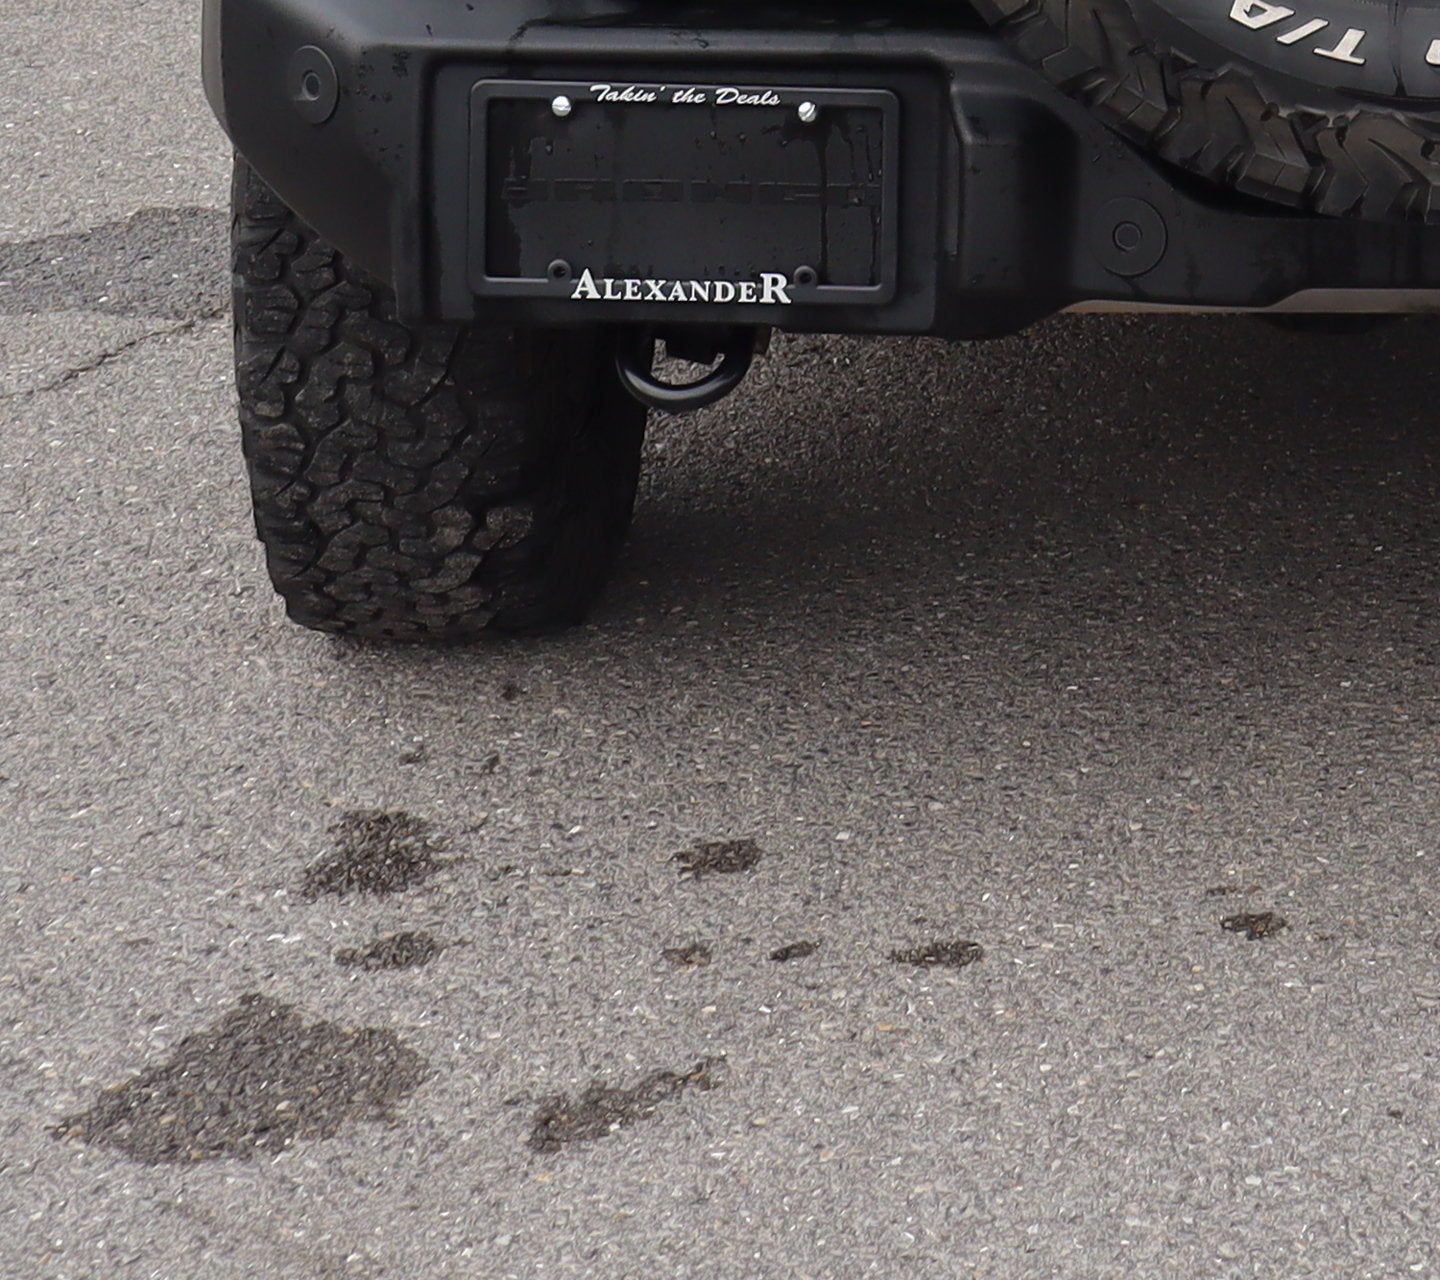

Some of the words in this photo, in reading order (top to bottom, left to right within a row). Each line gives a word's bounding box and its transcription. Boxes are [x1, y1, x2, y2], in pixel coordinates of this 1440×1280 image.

[589, 84, 666, 103] Takin'
[672, 87, 706, 103] the
[715, 87, 781, 105] Deals
[570, 268, 792, 304] ALEXANDER
